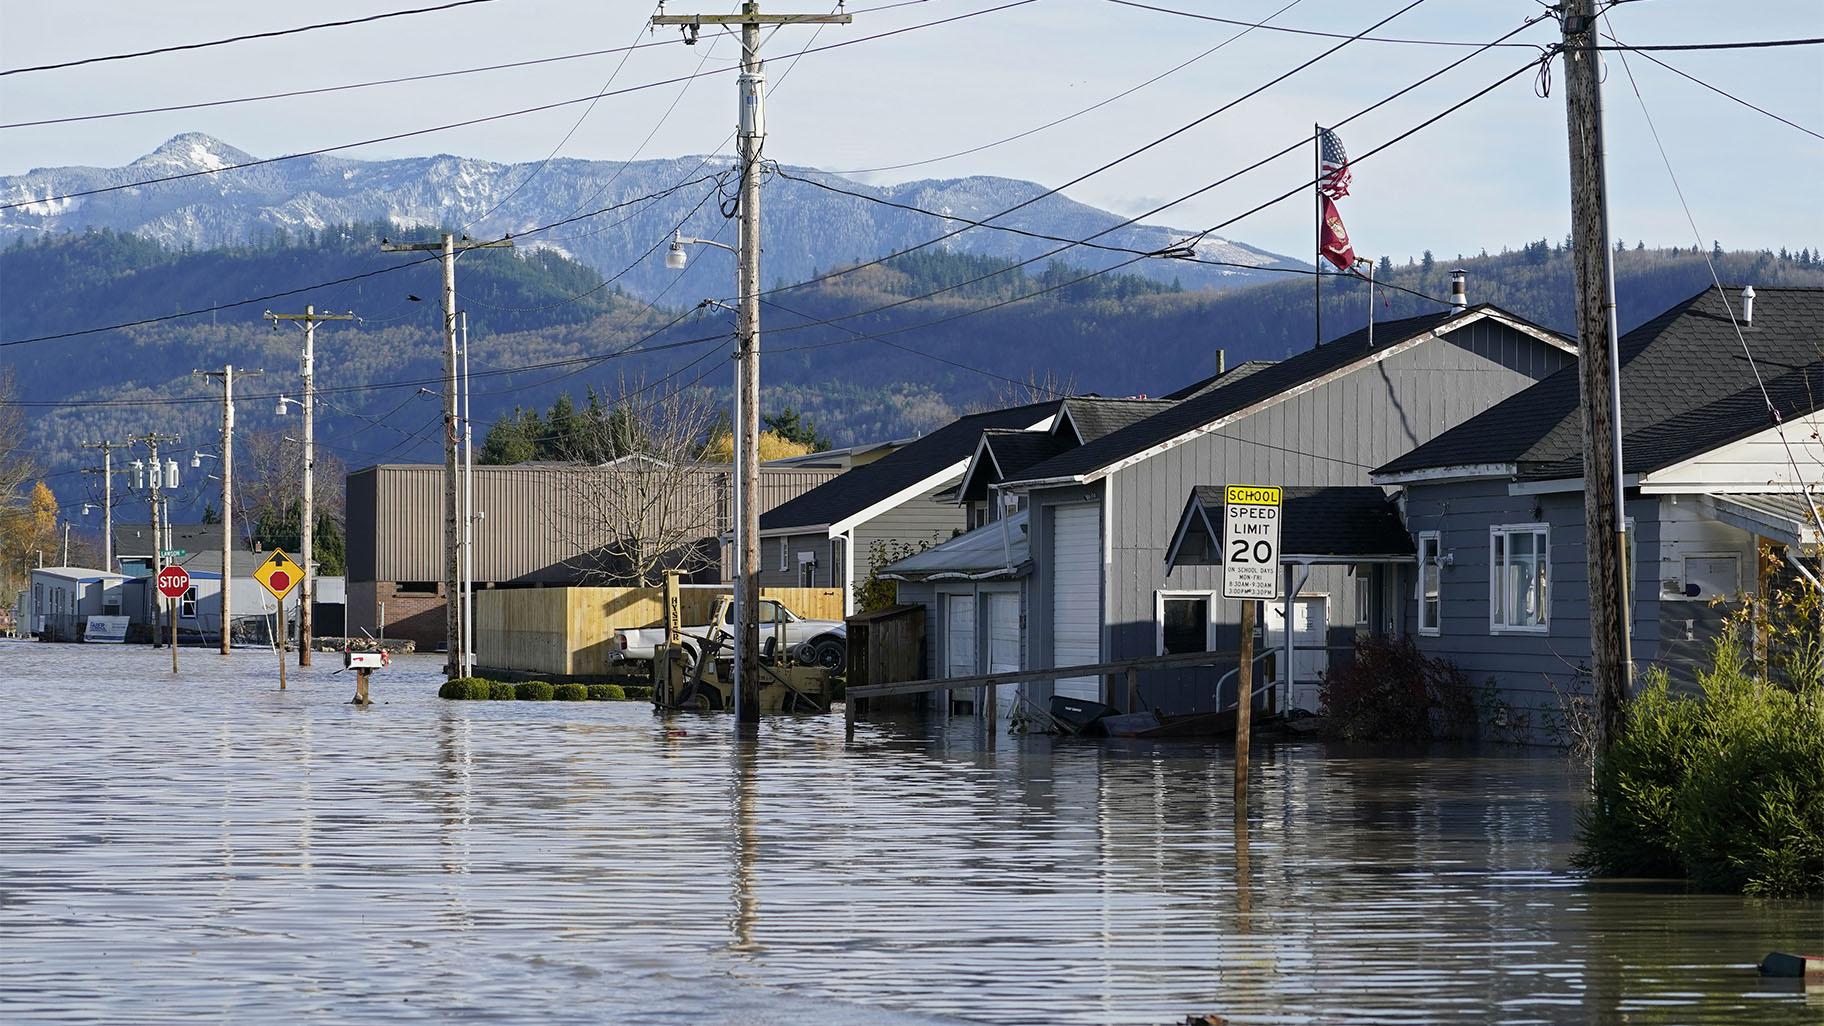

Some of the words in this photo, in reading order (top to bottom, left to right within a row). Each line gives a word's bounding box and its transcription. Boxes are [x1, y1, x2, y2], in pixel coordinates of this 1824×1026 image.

[1230, 490, 1277, 502] SCHOOL
[1230, 507, 1276, 519] SPEED
[1234, 524, 1270, 534] LIMIT
[1231, 540, 1272, 563] 20
[160, 576, 187, 588] STOP
